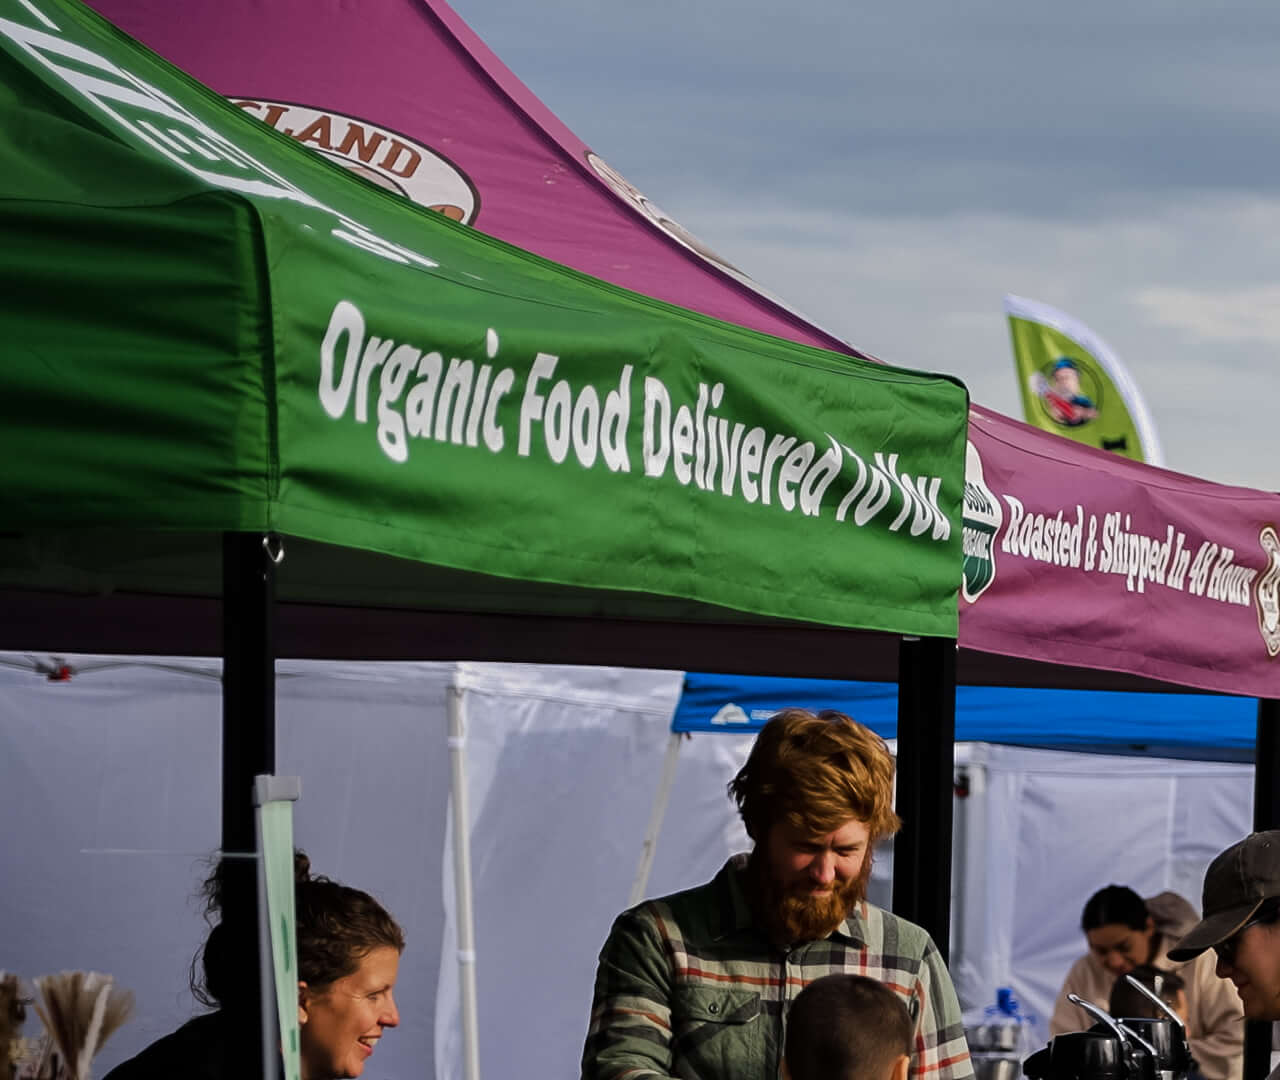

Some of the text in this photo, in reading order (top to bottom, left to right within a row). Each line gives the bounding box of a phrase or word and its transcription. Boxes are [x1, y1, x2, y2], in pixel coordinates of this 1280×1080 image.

[319, 300, 515, 463] Organic
[518, 352, 634, 474] Food
[643, 375, 843, 518] Delivered
[1002, 494, 1084, 568] Roasted
[1084, 514, 1097, 572] &
[1098, 511, 1175, 593] Shipped
[1166, 532, 1191, 591] In
[1188, 541, 1218, 597] 48
[1207, 547, 1258, 607] Hours
